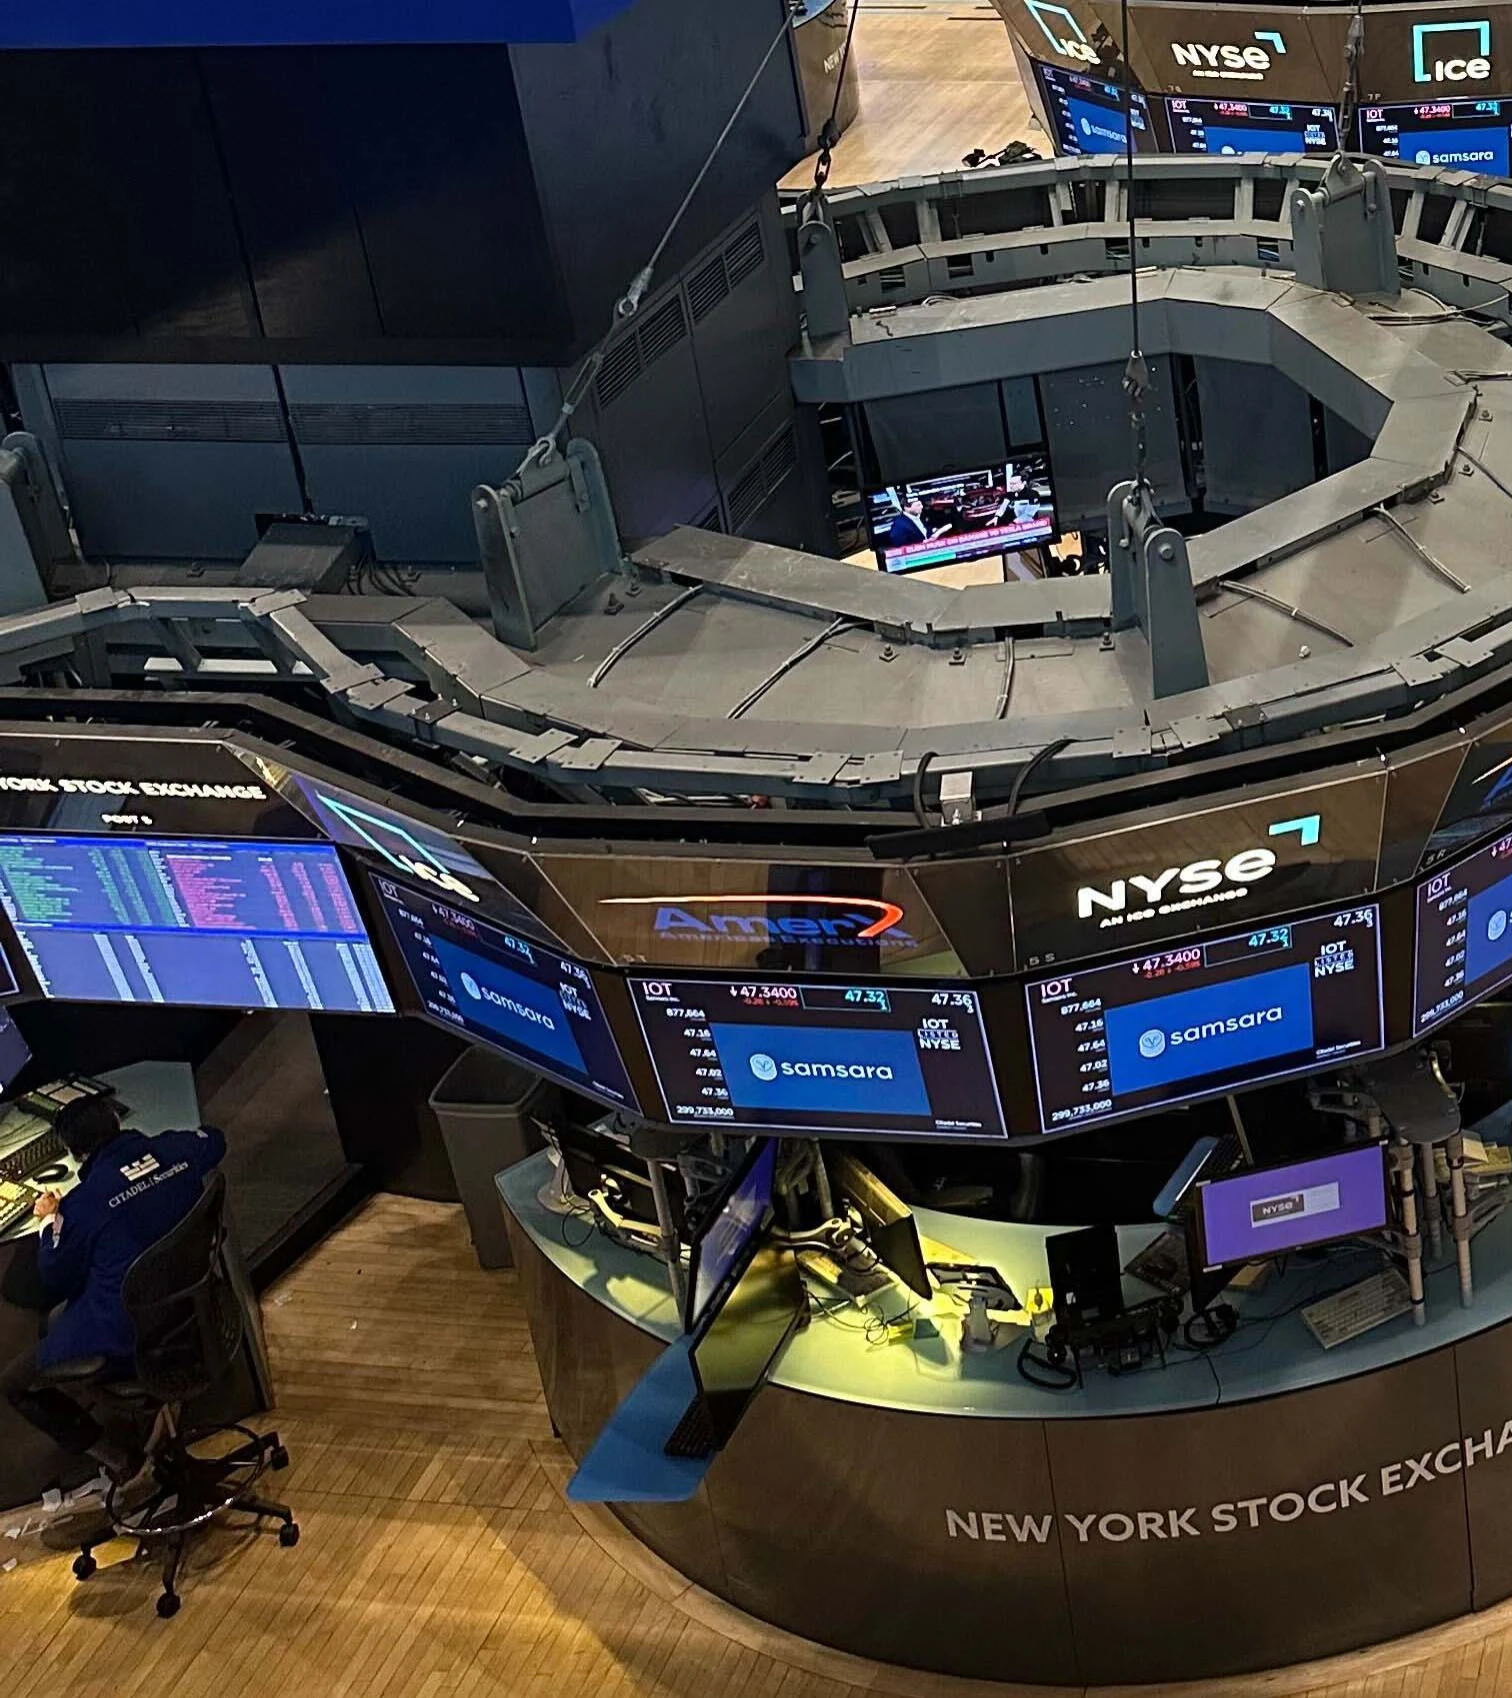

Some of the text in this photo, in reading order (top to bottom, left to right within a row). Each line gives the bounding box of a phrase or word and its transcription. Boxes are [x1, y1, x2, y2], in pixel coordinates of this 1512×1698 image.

[1432, 150, 1494, 164] samsara
[58, 779, 140, 795] STOCK
[139, 782, 267, 800] EXCHANGE
[1427, 872, 1451, 898] IOT
[1321, 940, 1347, 956] IOT
[1142, 949, 1201, 972] 47.3400
[1315, 962, 1355, 978] NYSE
[642, 982, 672, 996] IOT
[740, 986, 973, 1006] 47.3400 47.32 47.36
[1041, 978, 1073, 998] IOT
[481, 987, 555, 1031] samsara
[922, 1018, 949, 1029] IOT
[1170, 1006, 1283, 1045] samsara
[919, 1038, 961, 1050] NYSE
[780, 1062, 894, 1080] samsara
[108, 1181, 151, 1208] CITADEL
[946, 1509, 1052, 1543] NEW
[1064, 1507, 1201, 1542] YORK
[1212, 1474, 1371, 1534] STOCK
